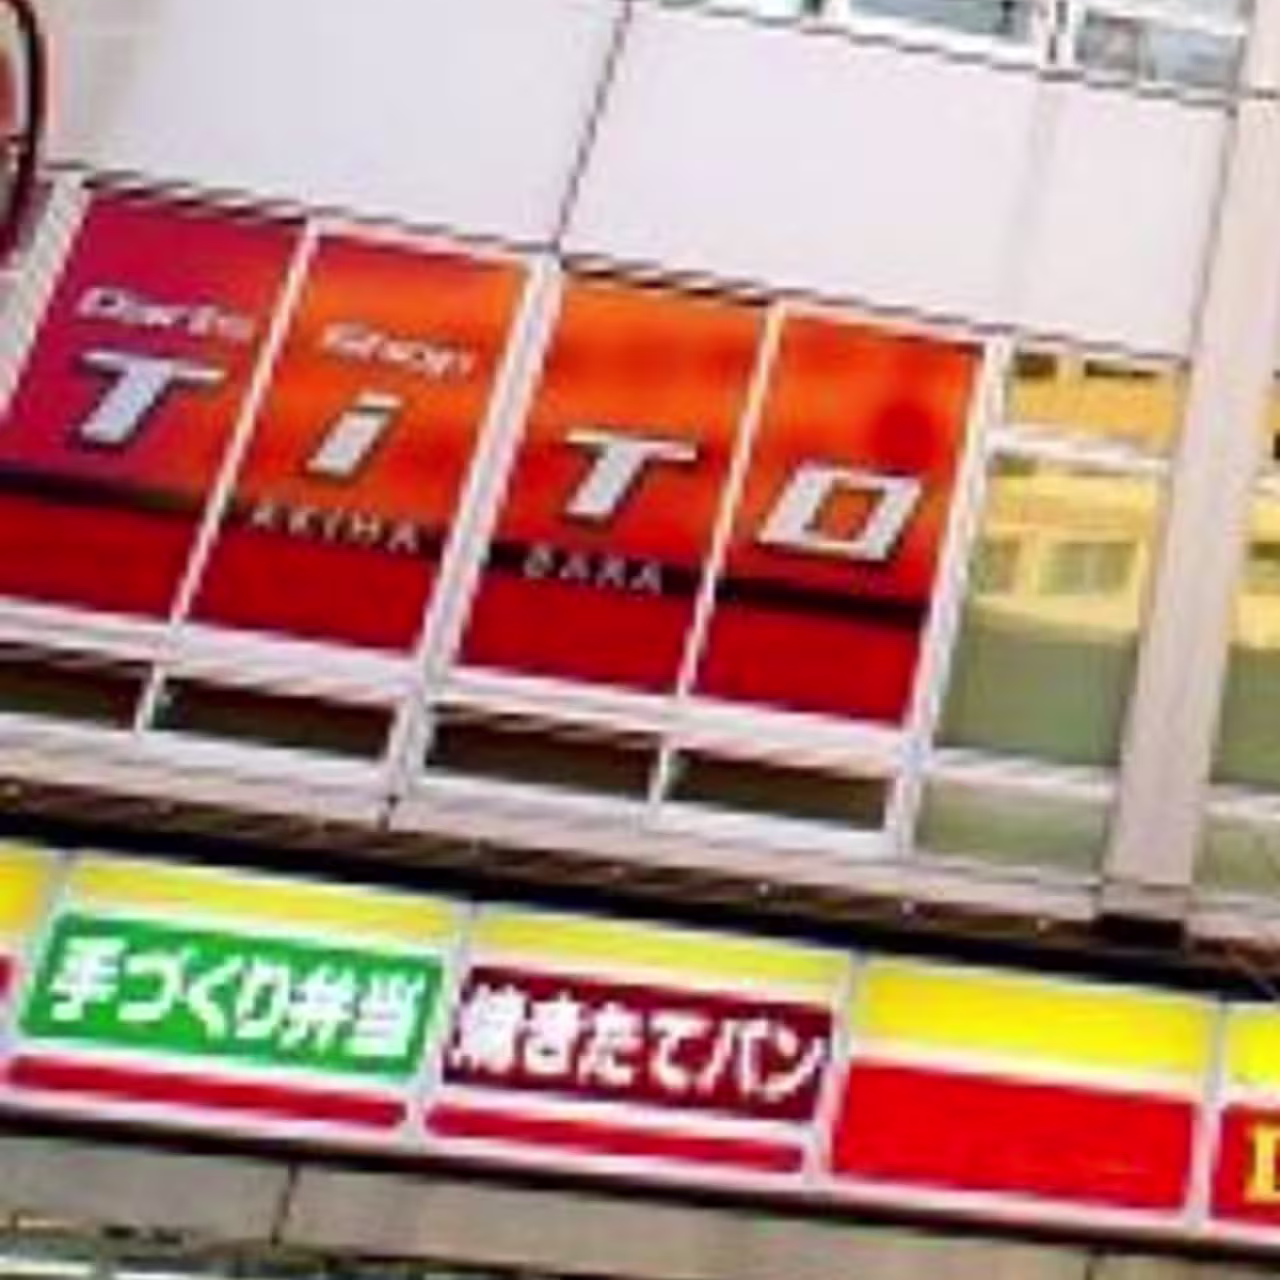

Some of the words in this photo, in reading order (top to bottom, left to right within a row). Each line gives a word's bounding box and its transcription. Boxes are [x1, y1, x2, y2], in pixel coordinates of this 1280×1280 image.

[50, 935, 426, 1060] 手づくり弁当
[450, 981, 824, 1101] 焼きたてパン
